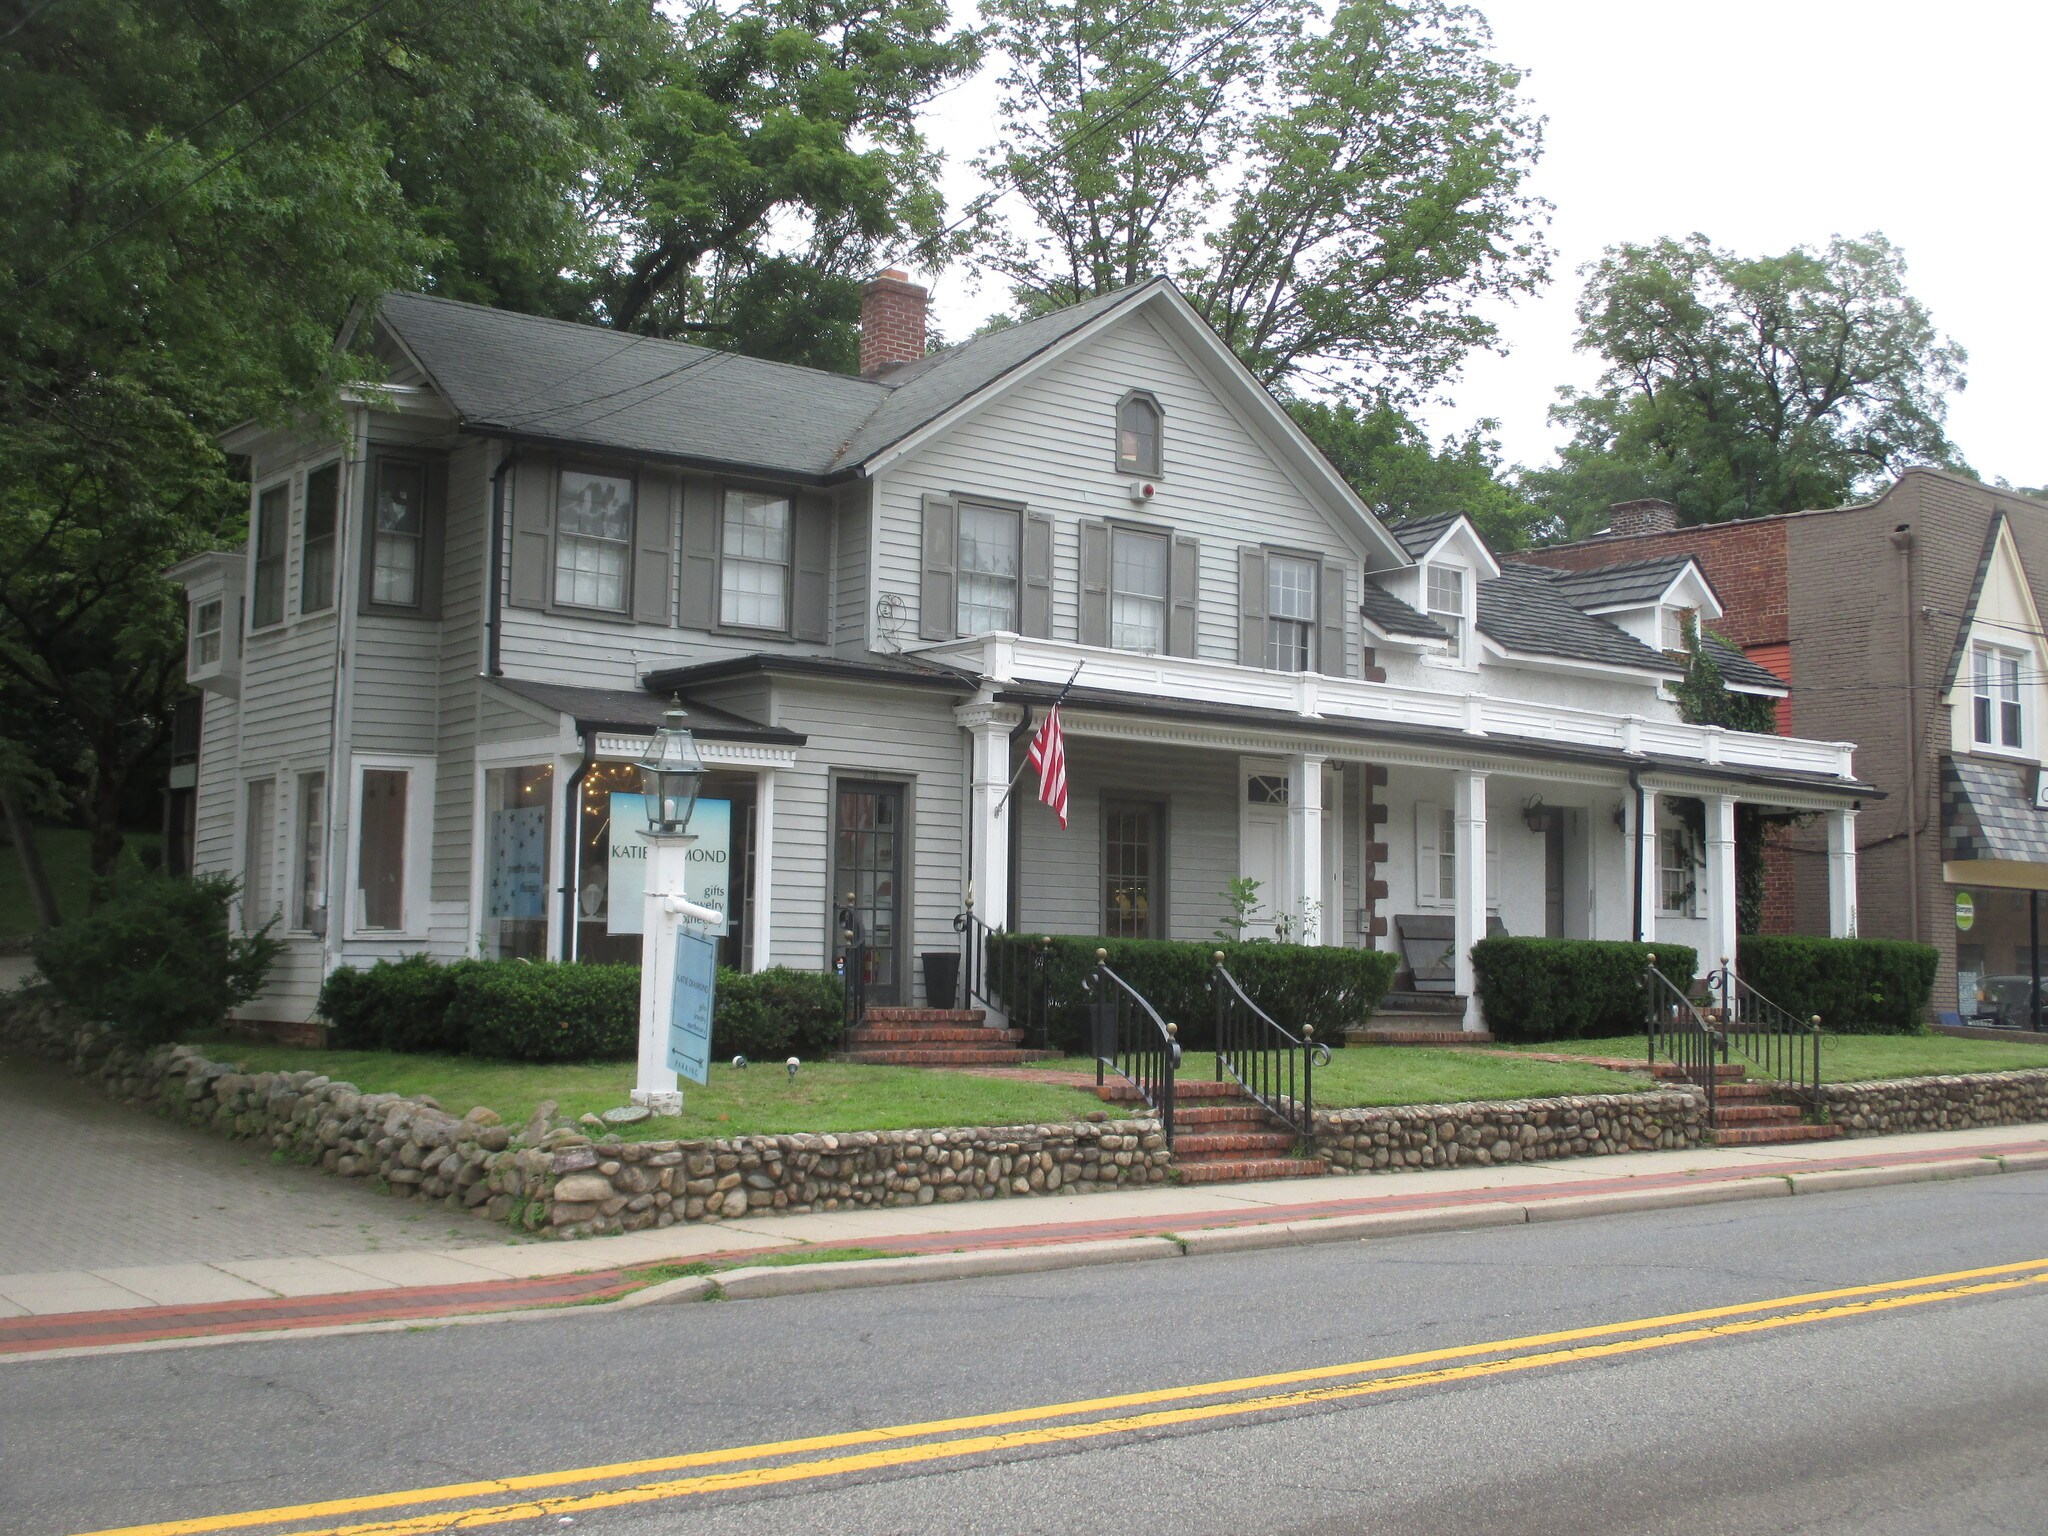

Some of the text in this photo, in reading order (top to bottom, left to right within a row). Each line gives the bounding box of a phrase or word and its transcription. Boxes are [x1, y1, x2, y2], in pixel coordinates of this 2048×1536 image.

[611, 844, 727, 863] KATIE MOND
[704, 884, 725, 898] gifts
[674, 1059, 699, 1077] PARKING
